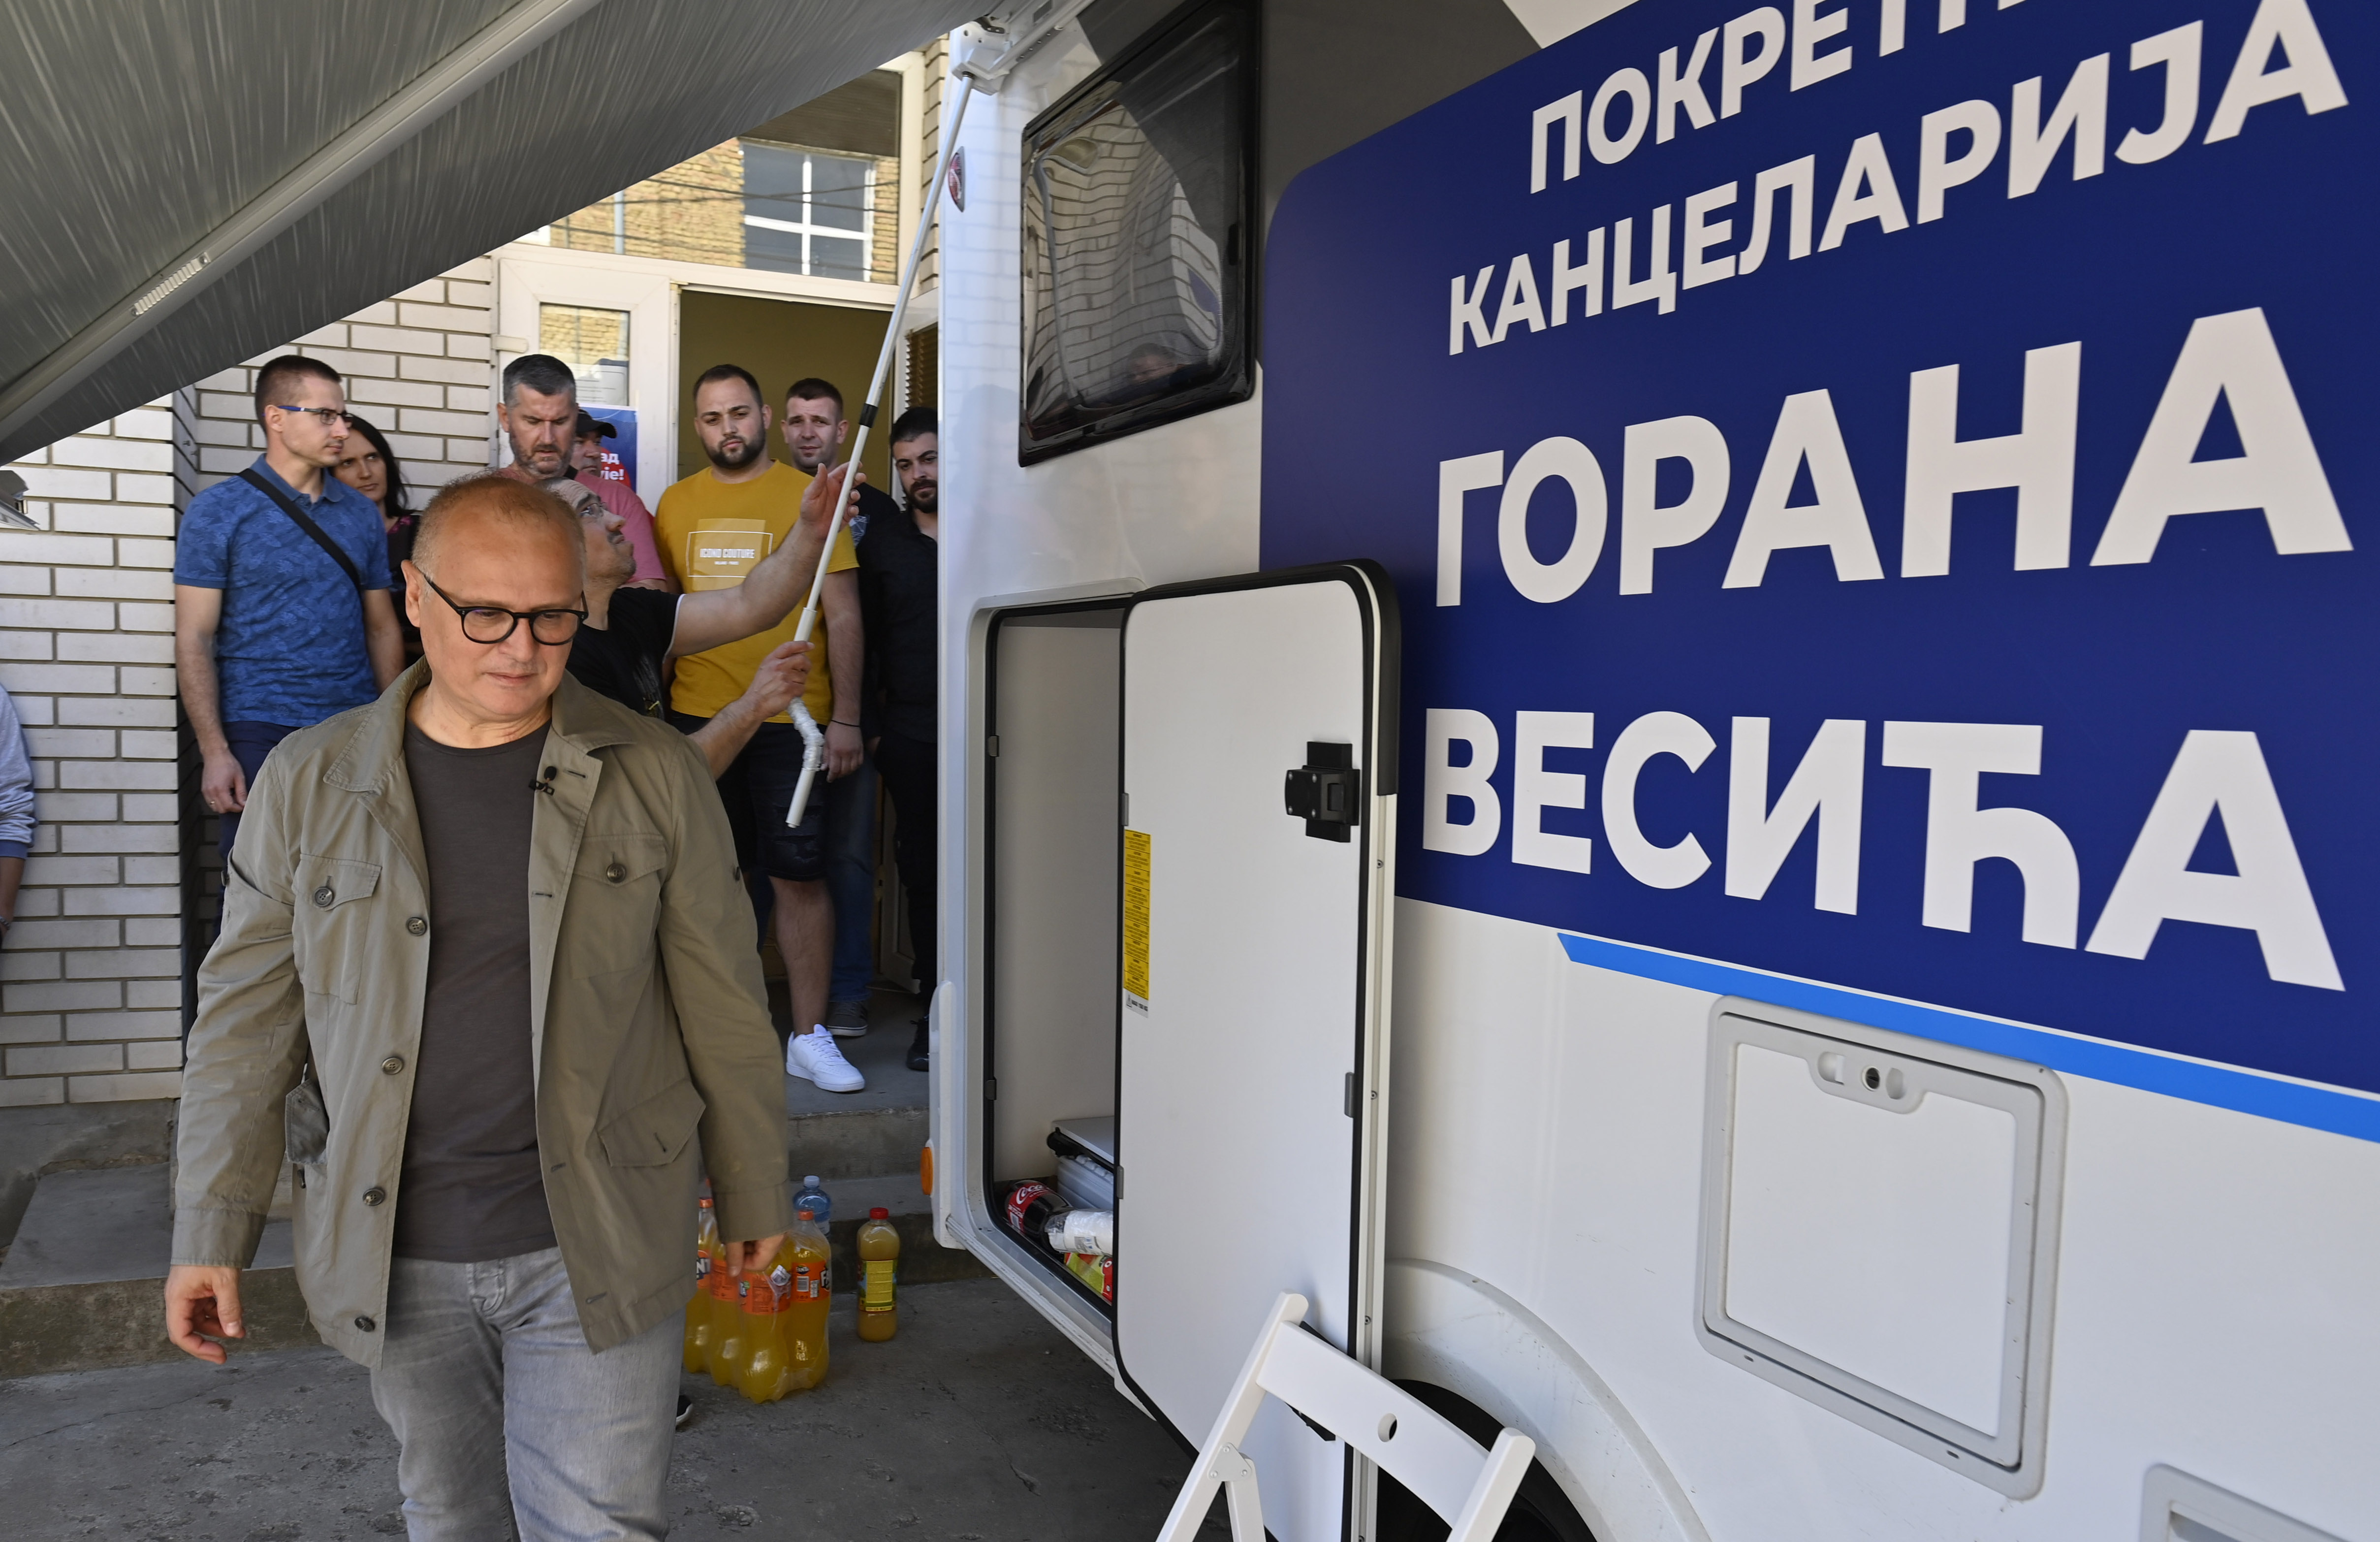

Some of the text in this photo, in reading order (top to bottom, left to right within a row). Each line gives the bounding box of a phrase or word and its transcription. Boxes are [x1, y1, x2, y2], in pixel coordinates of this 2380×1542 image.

[1449, 0, 2348, 356] КАНЦЕЛАРИЈА
[1530, 0, 2026, 194] ПОКРЕ
[1436, 306, 2354, 607] ГОРАНА
[1423, 708, 2346, 992] ВЕСИЋА
